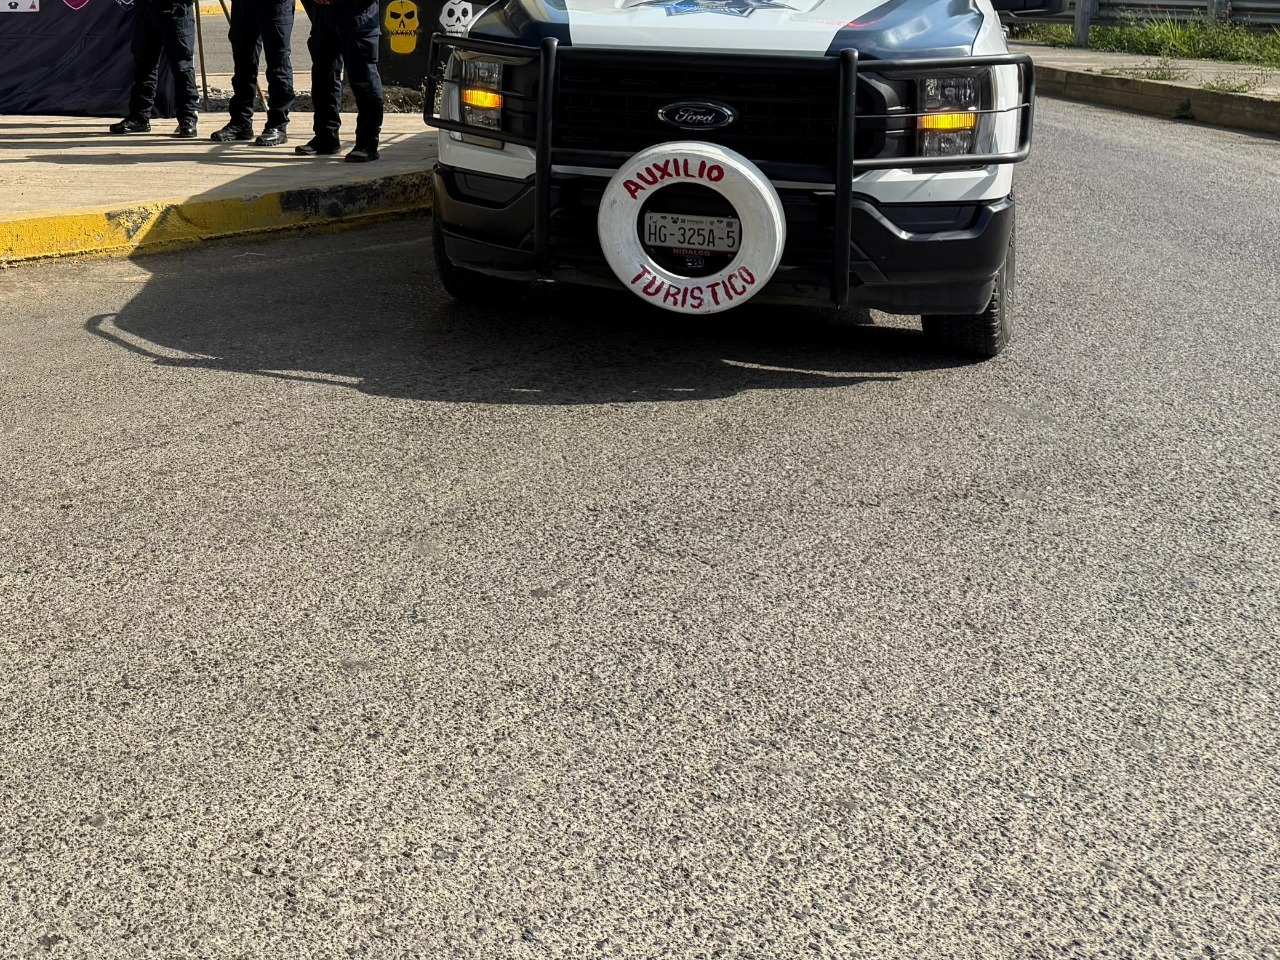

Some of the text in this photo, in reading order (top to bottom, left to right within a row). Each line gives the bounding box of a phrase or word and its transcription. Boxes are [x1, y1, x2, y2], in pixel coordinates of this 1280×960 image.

[675, 107, 715, 124] Ford
[623, 158, 725, 199] AUXILIO
[648, 223, 736, 248] HG-325A-5
[673, 248, 710, 256] HIDALGO
[631, 264, 756, 309] TURISTICO
